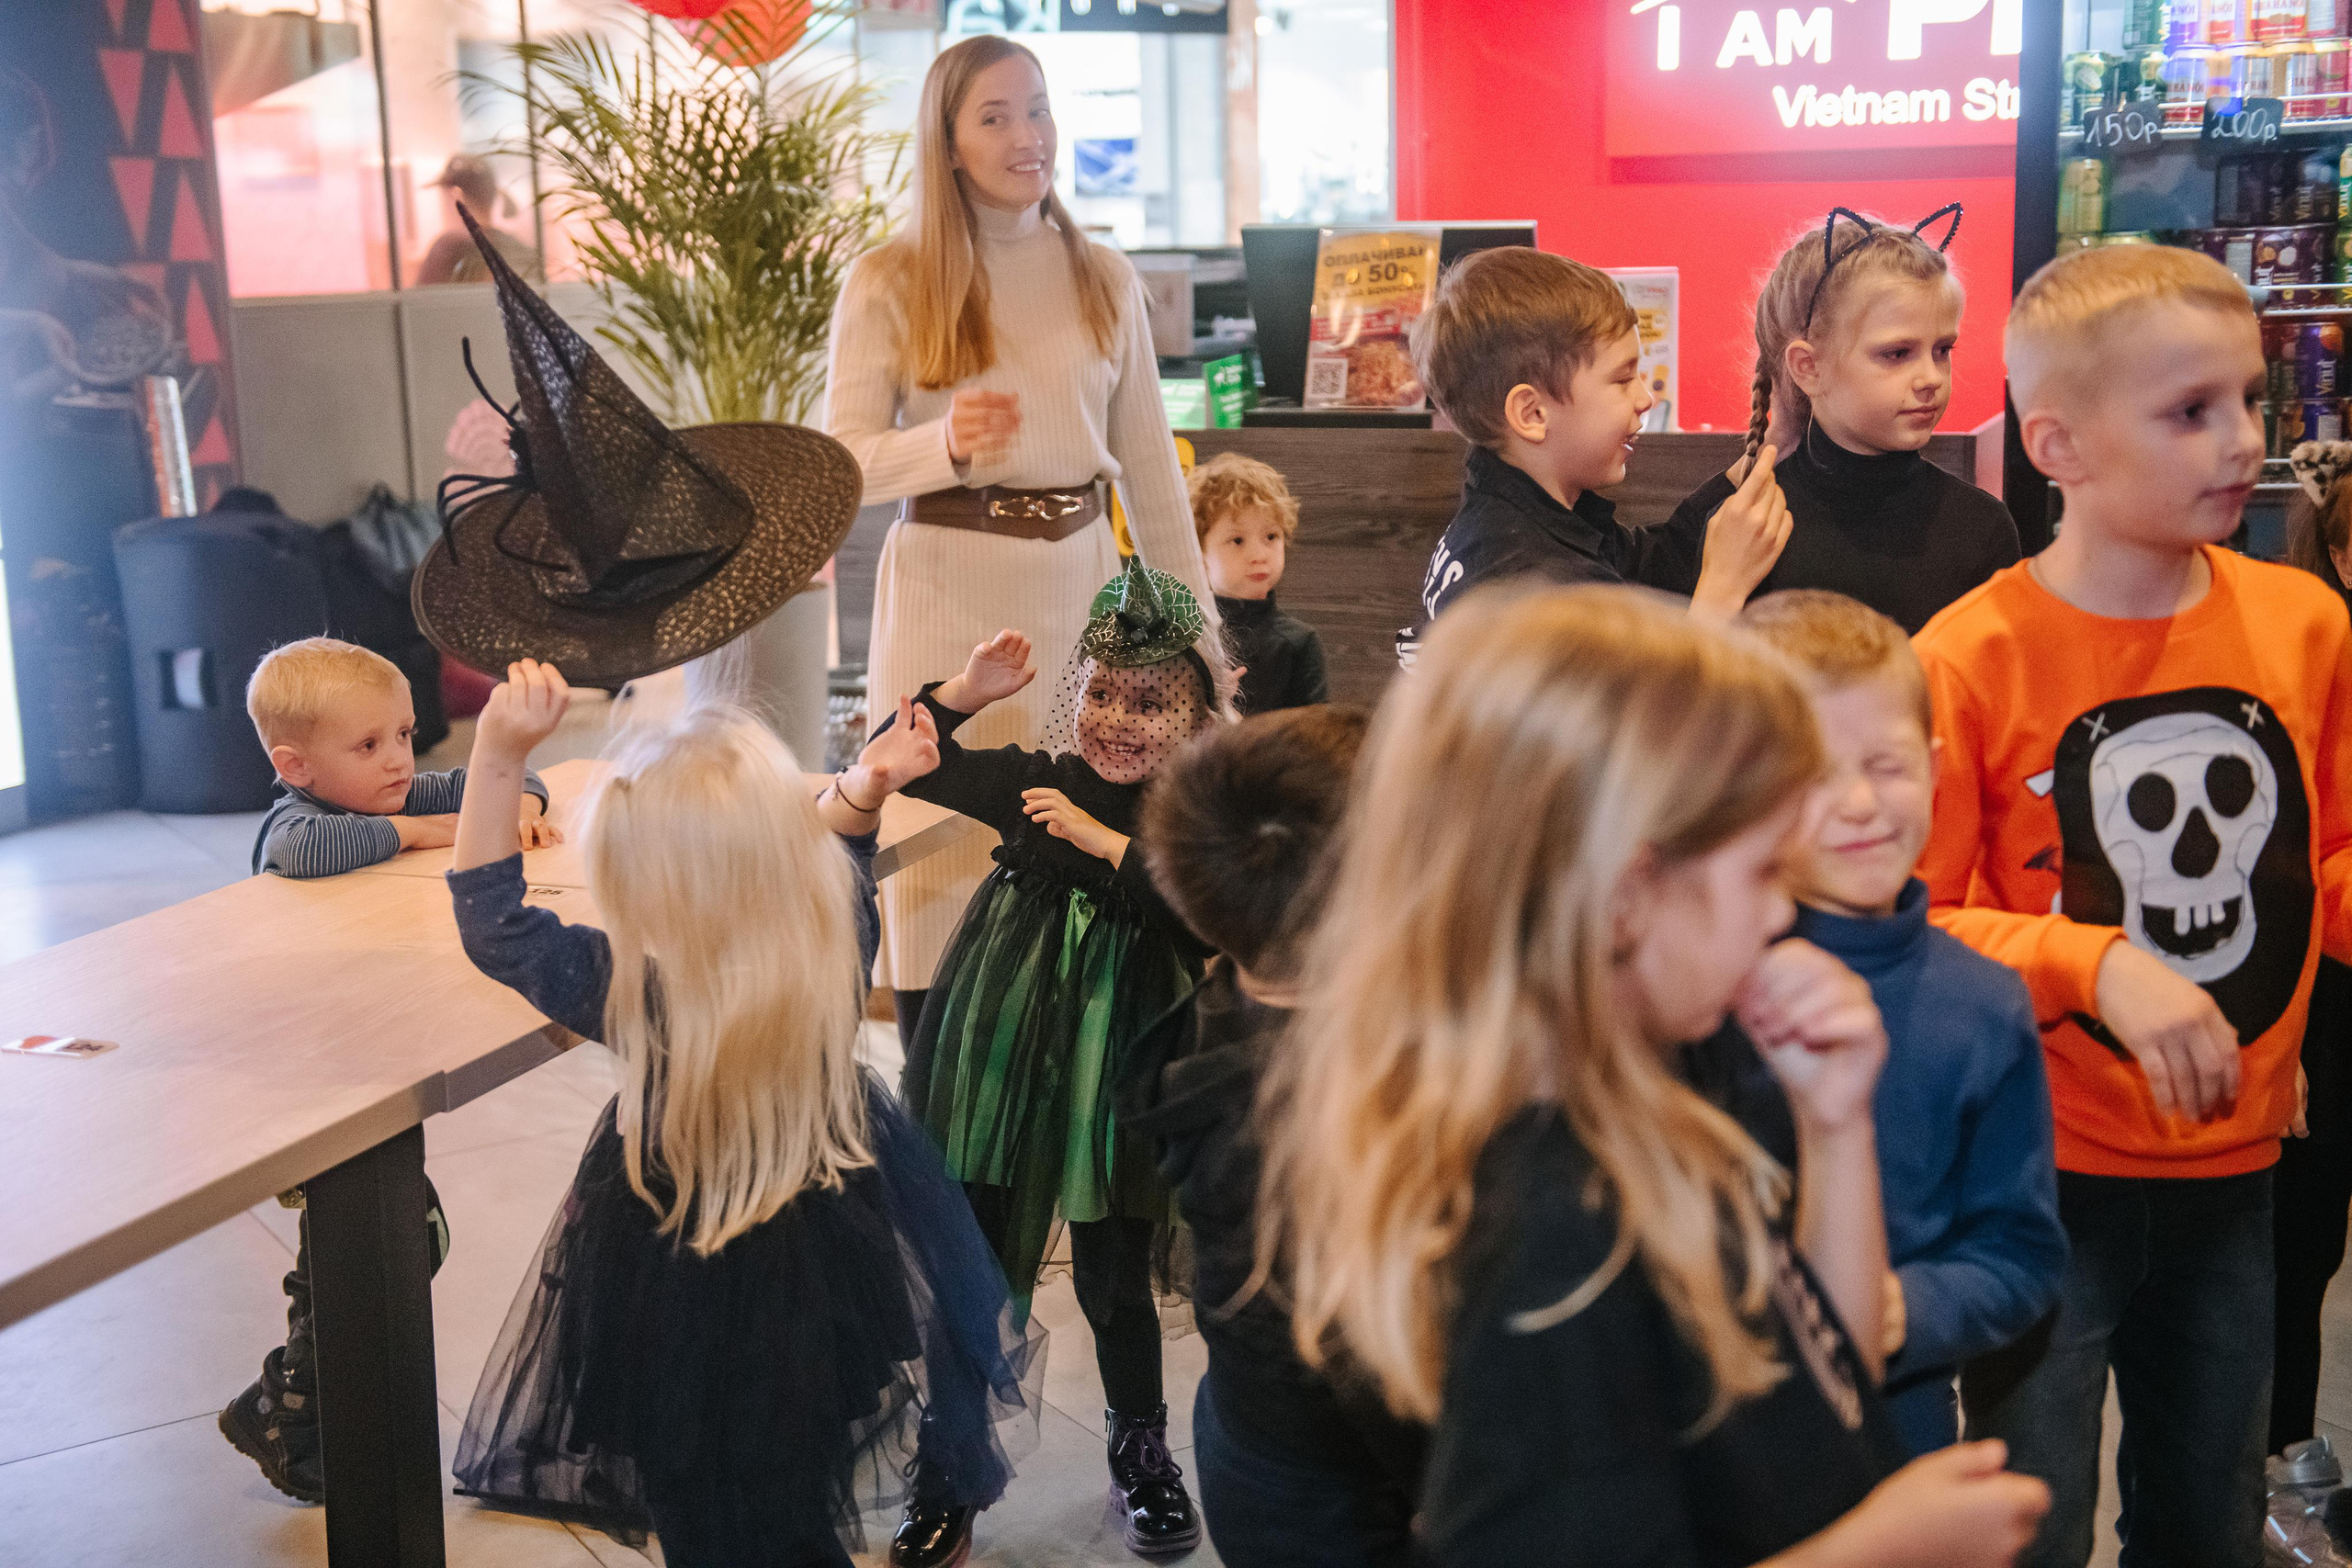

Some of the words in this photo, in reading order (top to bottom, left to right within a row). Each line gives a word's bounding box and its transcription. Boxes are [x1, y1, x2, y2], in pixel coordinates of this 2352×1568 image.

[1657, 5, 1680, 71] I
[1714, 7, 1833, 69] AM
[1772, 84, 1951, 128] Vietnam
[2315, 359, 2336, 396] Vinut
